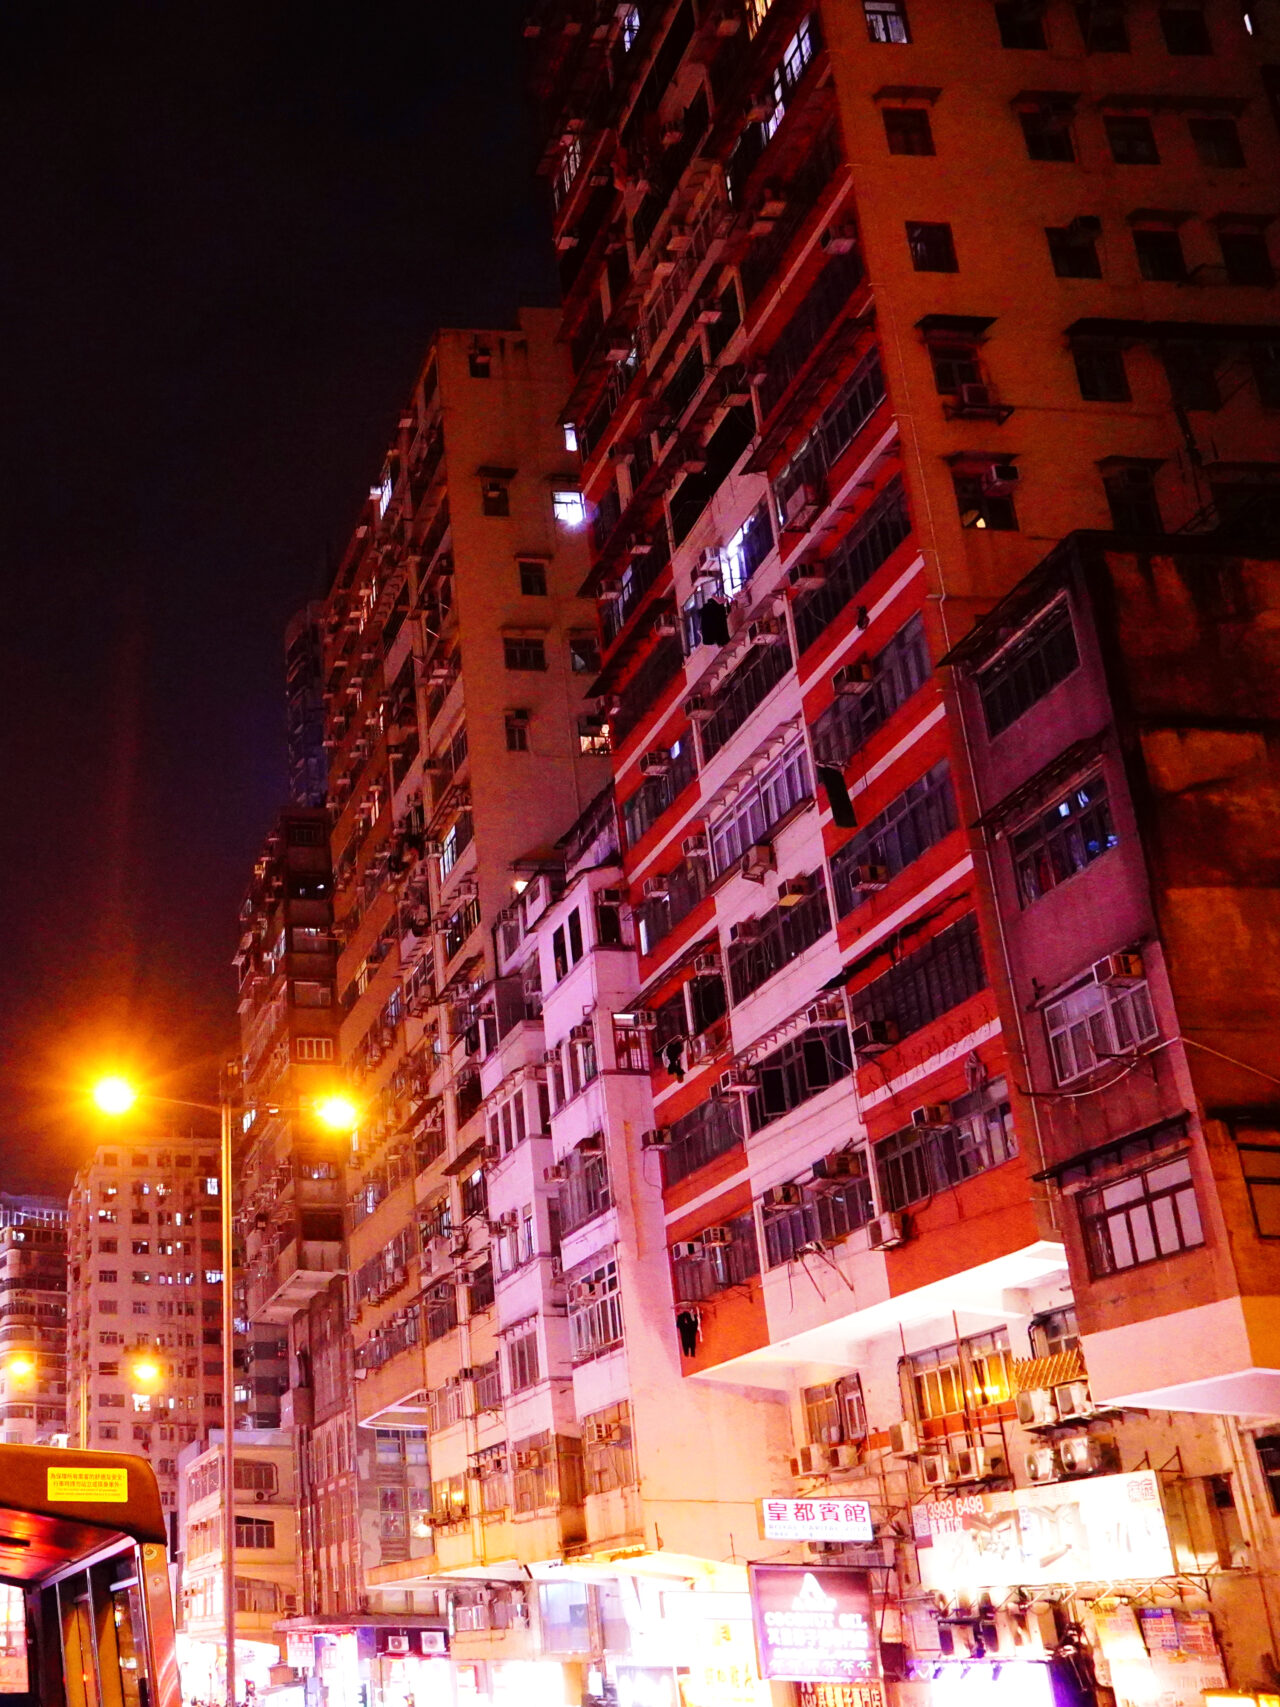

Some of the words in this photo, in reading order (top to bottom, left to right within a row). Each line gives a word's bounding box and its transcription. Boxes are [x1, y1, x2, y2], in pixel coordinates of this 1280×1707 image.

[767, 1502, 866, 1523] 皇都賓館
[955, 1495, 985, 1517] 6498
[764, 1611, 835, 1628] COCONUT
[839, 1613, 868, 1629] OIL
